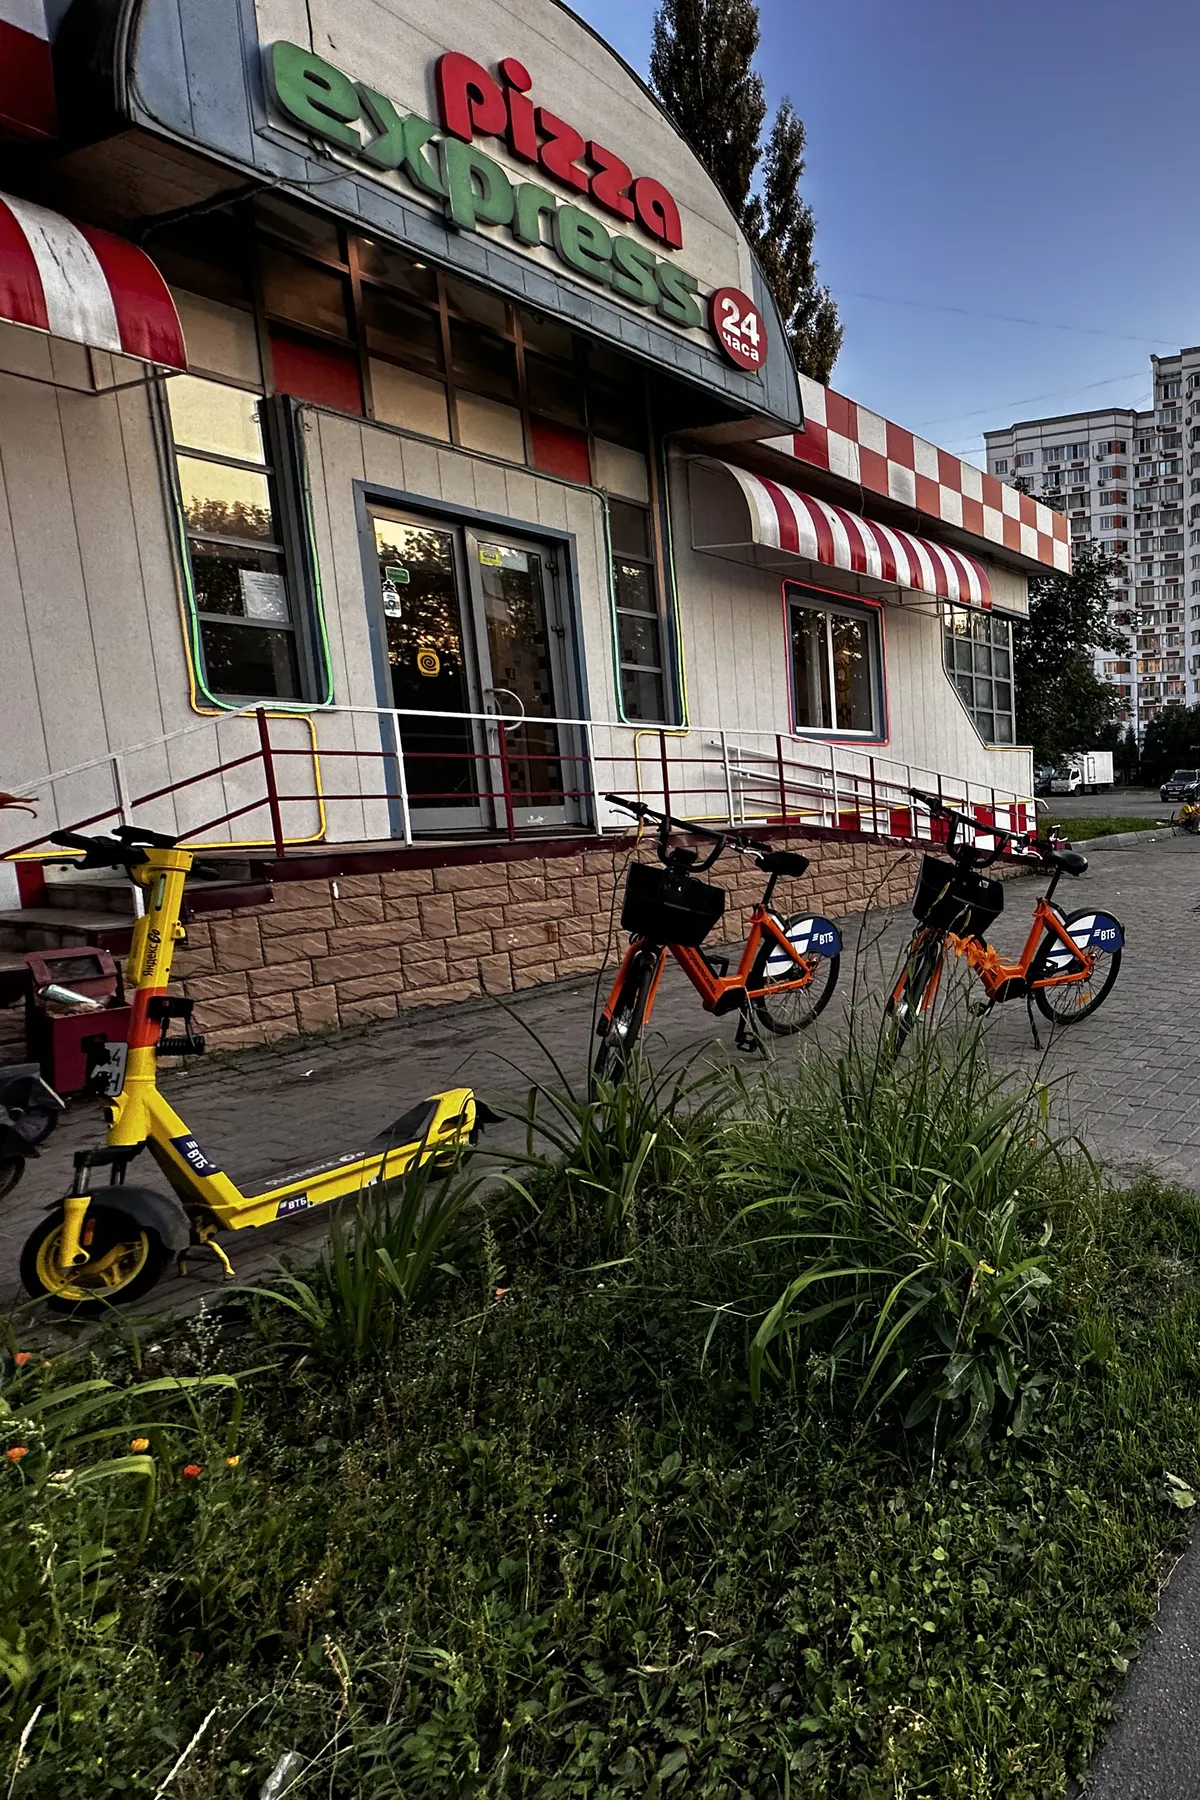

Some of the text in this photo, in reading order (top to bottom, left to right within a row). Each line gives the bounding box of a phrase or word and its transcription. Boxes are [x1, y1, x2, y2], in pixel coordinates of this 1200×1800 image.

[435, 51, 683, 250] pizza
[266, 40, 702, 328] express
[721, 297, 760, 347] 24
[722, 331, 760, 363] часа
[819, 931, 834, 945] ВТБ
[1100, 928, 1116, 941] ВТБ
[142, 929, 162, 977] Яндекс Go
[187, 1149, 209, 1169] ВТБ
[288, 1197, 307, 1210] ВТБ
